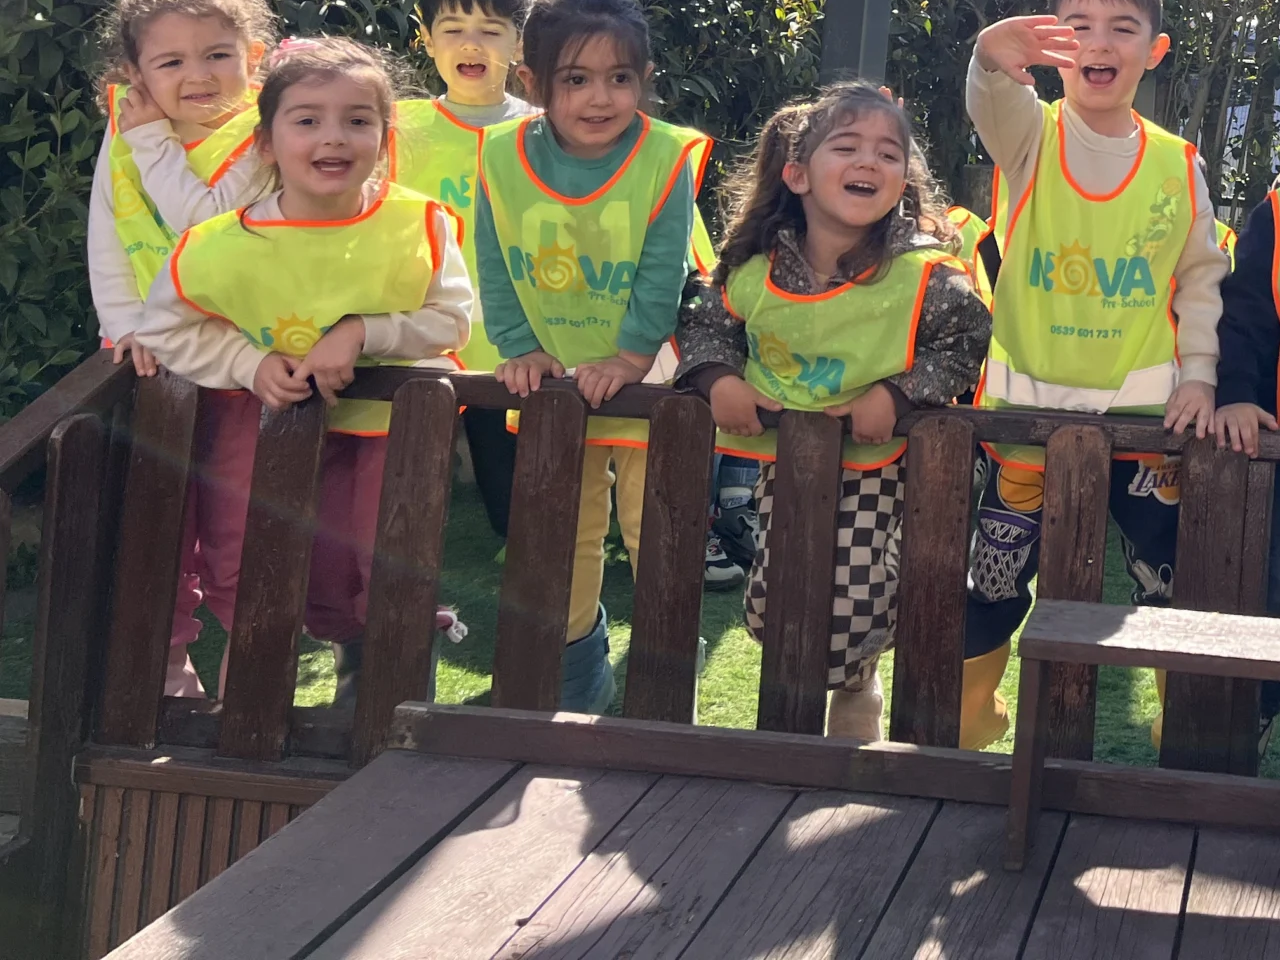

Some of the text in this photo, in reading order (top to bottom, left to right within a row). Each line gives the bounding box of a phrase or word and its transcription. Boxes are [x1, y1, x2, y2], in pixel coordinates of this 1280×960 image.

[1029, 237, 1156, 298] NOVA
[588, 290, 628, 306] Pre-Sch
[1101, 297, 1155, 309] Pre-School
[1050, 325, 1122, 339] 0539 601 73 71
[1134, 465, 1180, 493] LAKE
